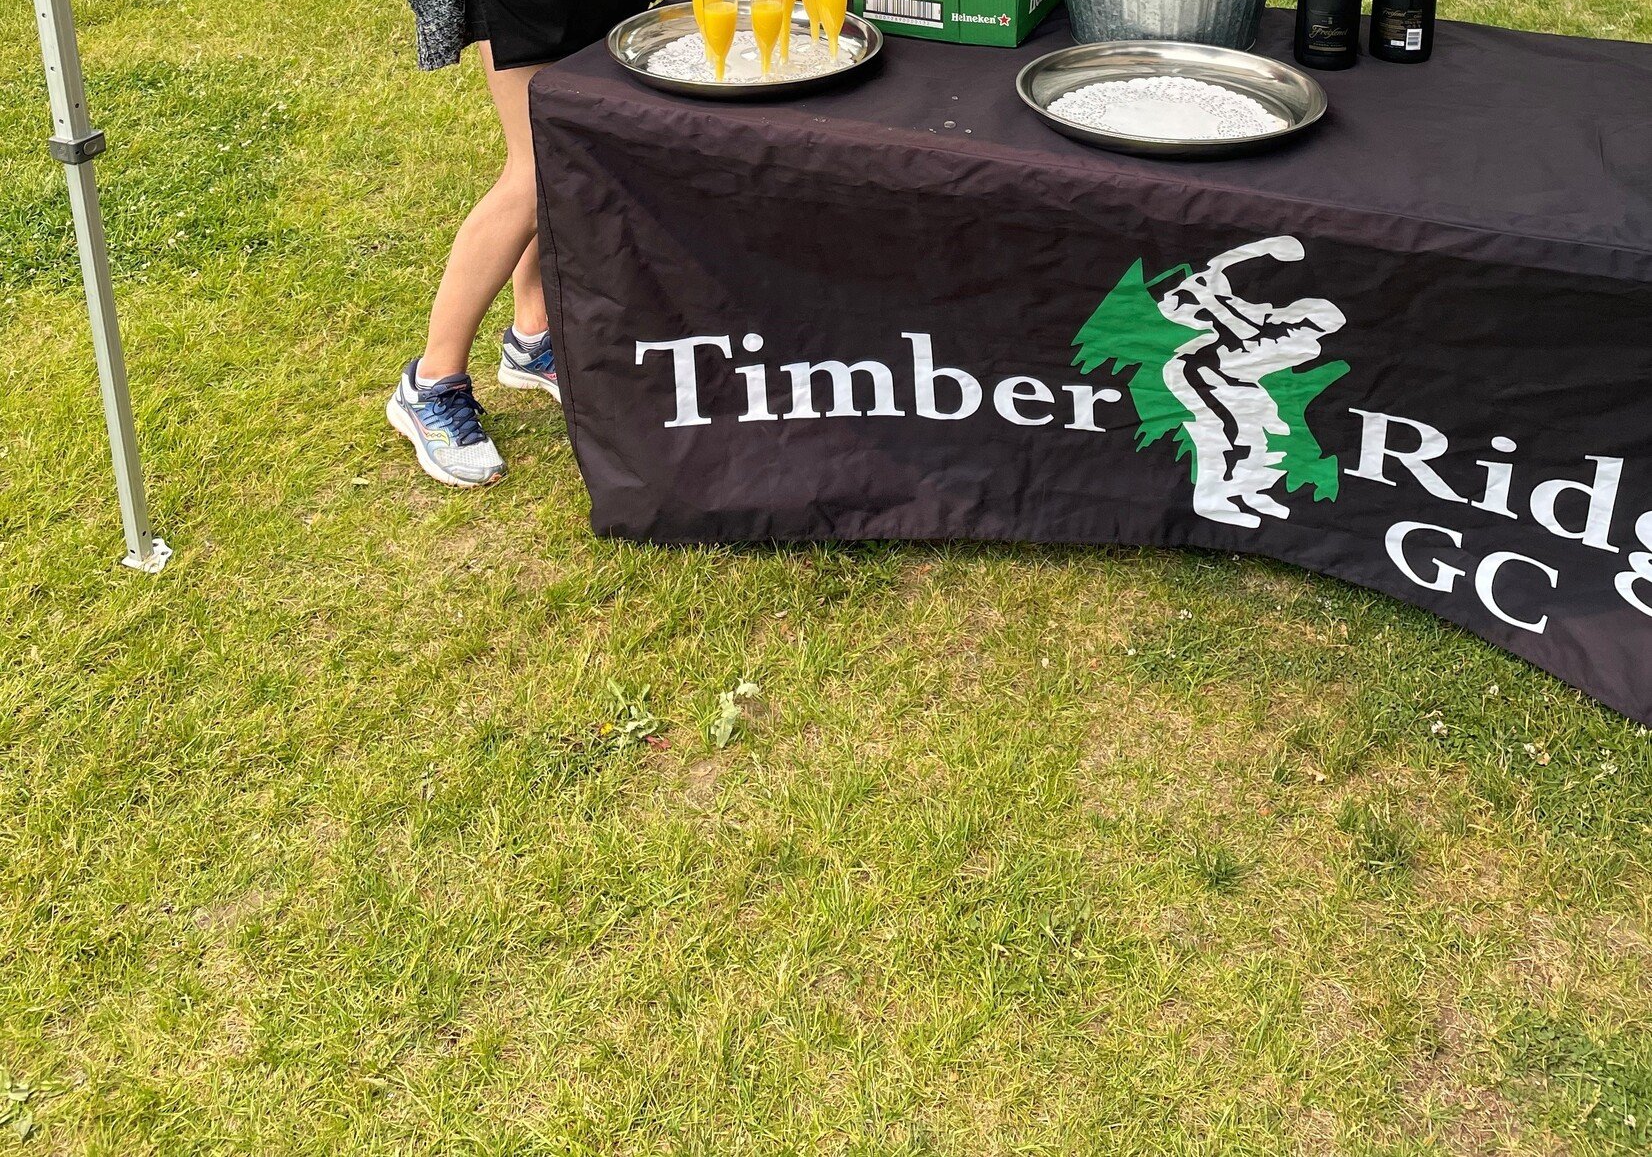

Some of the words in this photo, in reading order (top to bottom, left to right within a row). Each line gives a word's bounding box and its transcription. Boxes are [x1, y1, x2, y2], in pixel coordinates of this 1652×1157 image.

[951, 12, 997, 25] Heineken
[635, 331, 1122, 433] Timber
[1384, 520, 1560, 635] GC
